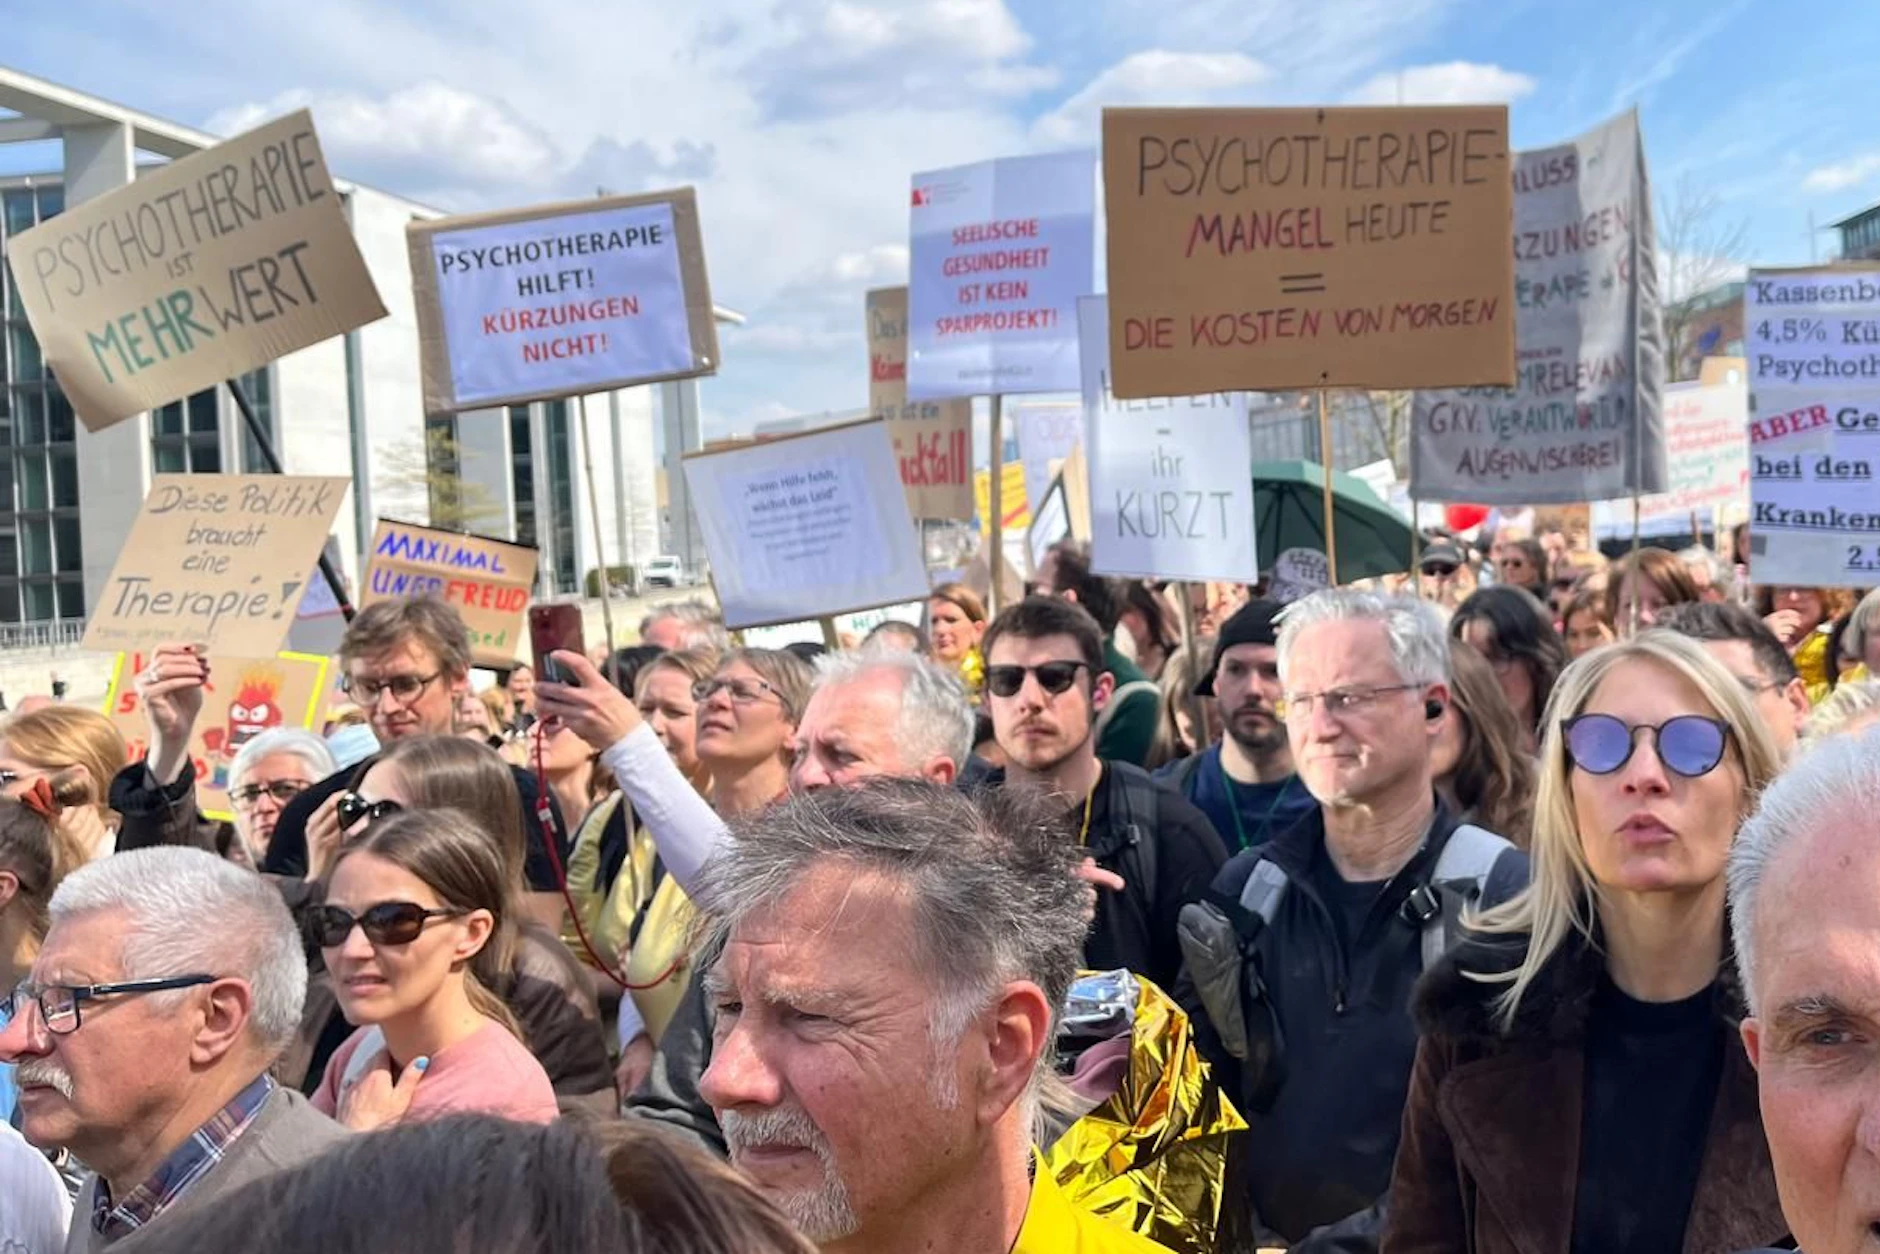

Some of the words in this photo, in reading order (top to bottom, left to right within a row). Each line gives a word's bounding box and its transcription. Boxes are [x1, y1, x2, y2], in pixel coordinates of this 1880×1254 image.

[1138, 128, 1506, 198] PSYCHOTHERAPIE-
[33, 131, 326, 312] PSYCHOTHERAPIE
[951, 218, 1039, 246] SEELISCHE
[1185, 207, 1334, 258] MANGEL
[1345, 200, 1452, 244] HEUTE
[440, 224, 663, 275] PSYCHOTHERAPIE
[942, 247, 1050, 277] GESUNDHEIT
[166, 252, 196, 280] IST
[517, 268, 595, 297] HILFT!
[957, 284, 981, 304] IST
[985, 281, 1029, 301] KEIN
[1754, 278, 1880, 304] Kassenb
[482, 296, 640, 335] KÜRZUNGEN
[935, 308, 1058, 337] SPARPROJEKT!
[1125, 317, 1176, 351] DIE
[1190, 308, 1322, 348] KOSTEN
[1335, 306, 1384, 338] VON
[1390, 297, 1499, 334] MORGEN
[1756, 319, 1827, 345] 4,5%
[522, 333, 608, 364] NICHT!
[1749, 403, 1831, 443] ABER
[1836, 406, 1880, 430] Ge
[1151, 446, 1183, 479] ihr
[1755, 454, 1803, 477] bei
[1815, 454, 1872, 477] den
[150, 485, 230, 514] Diese
[239, 481, 331, 516] Politik
[185, 520, 267, 546] braucht
[181, 550, 231, 574] eine
[376, 532, 506, 574] MAXIMAL
[1847, 545, 1880, 570] 2,
[112, 575, 303, 633] Therapie!
